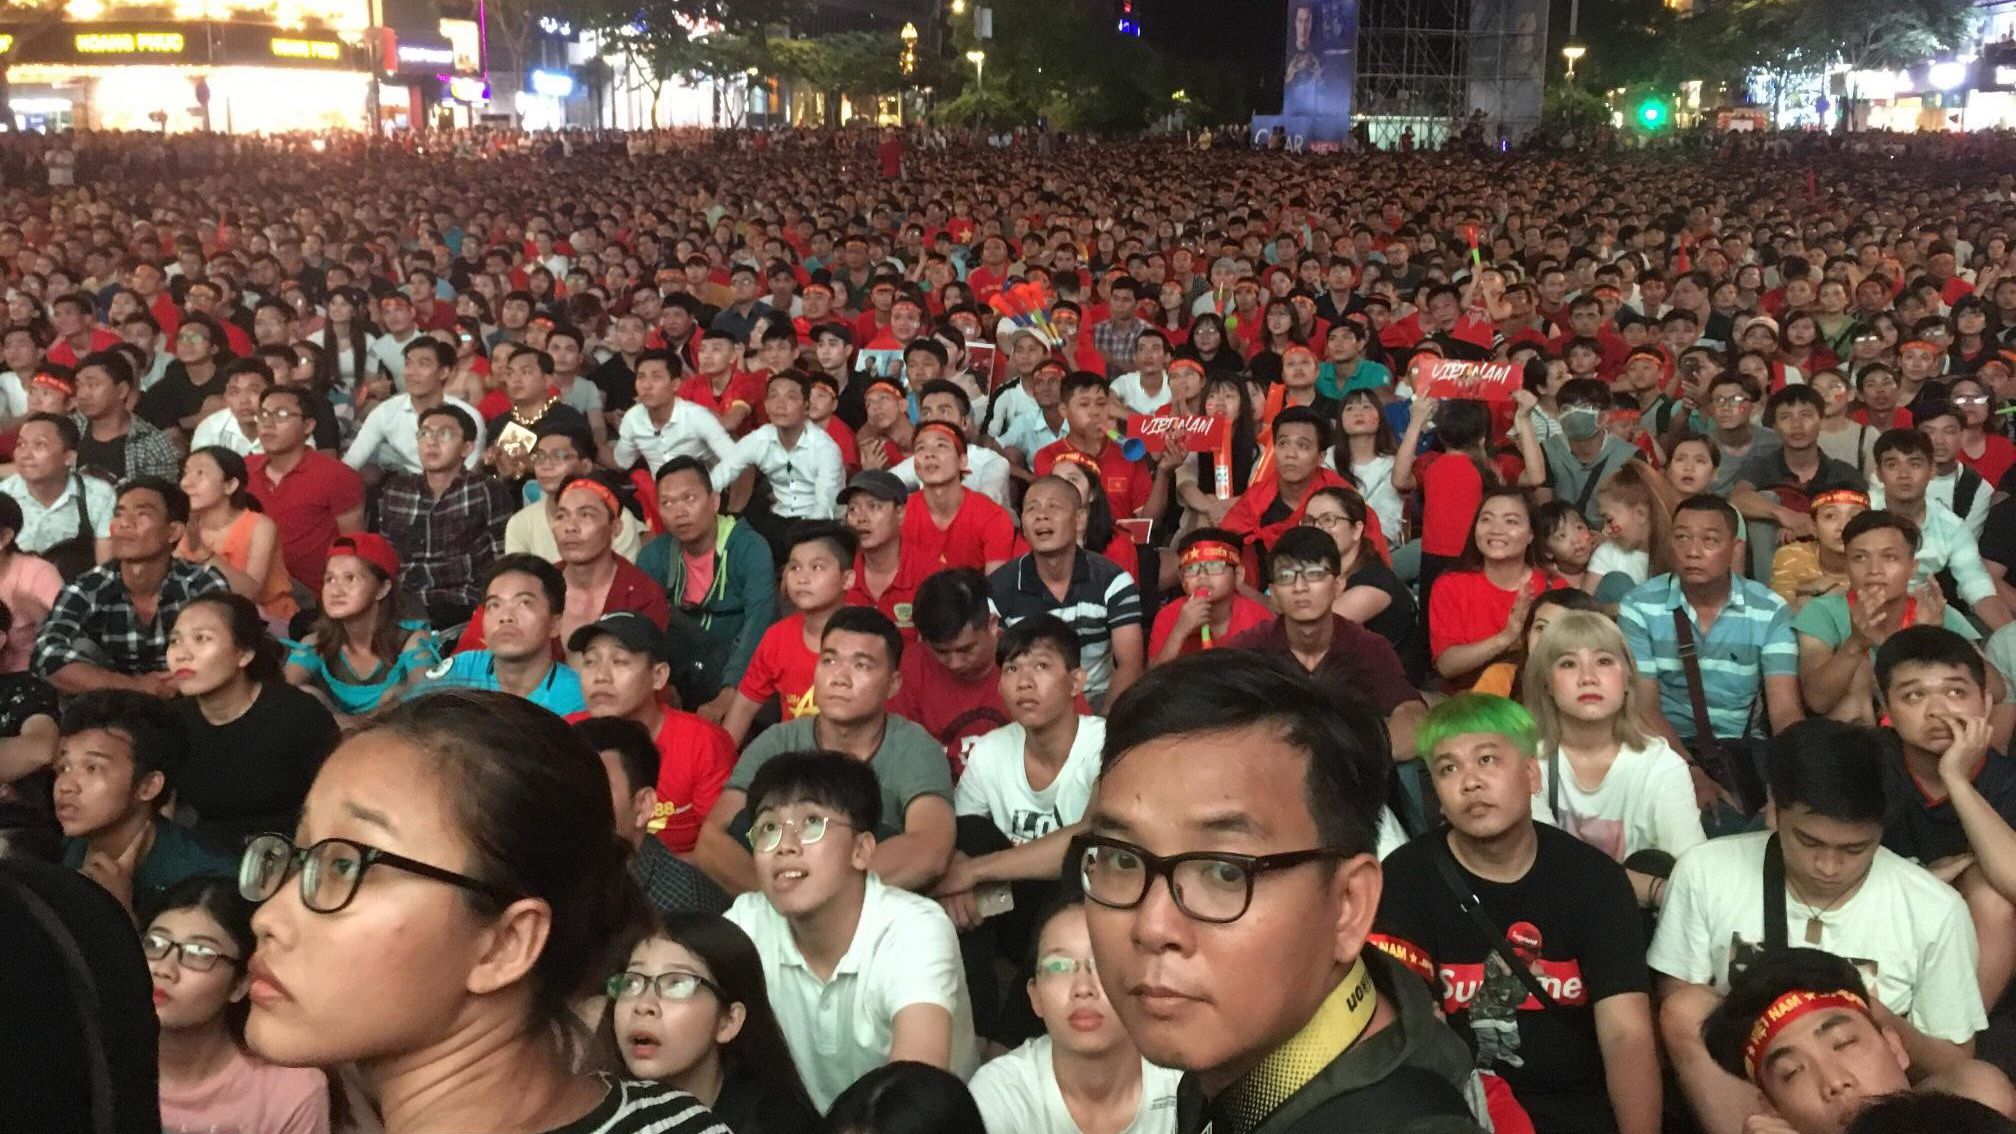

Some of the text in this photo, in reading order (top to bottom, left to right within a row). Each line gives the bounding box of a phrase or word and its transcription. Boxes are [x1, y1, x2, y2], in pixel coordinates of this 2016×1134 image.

[1379, 941, 1407, 961] NAM
[1439, 967, 1583, 1004] Sume
[1767, 994, 1803, 1022] NAM
